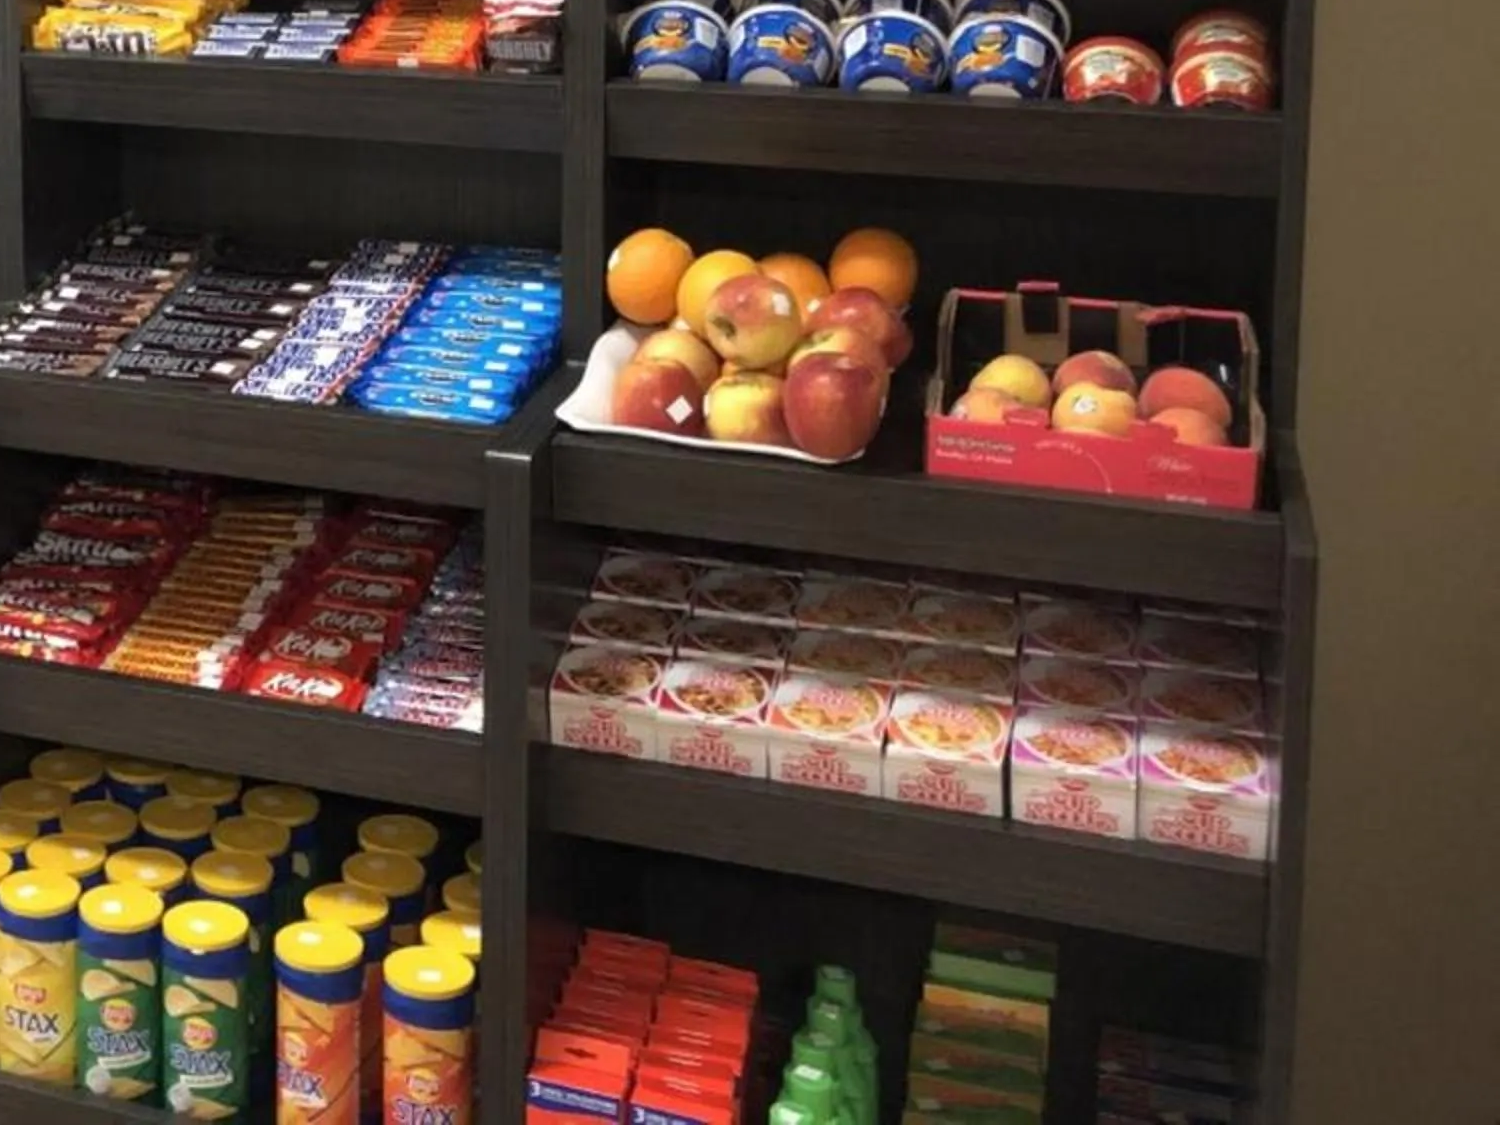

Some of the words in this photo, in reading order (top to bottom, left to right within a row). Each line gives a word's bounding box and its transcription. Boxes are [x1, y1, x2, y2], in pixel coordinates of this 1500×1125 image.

[1049, 791, 1102, 813] CUP
[1177, 810, 1232, 832] CUP
[4, 1005, 60, 1034] STAX
[86, 1026, 150, 1055] STAX
